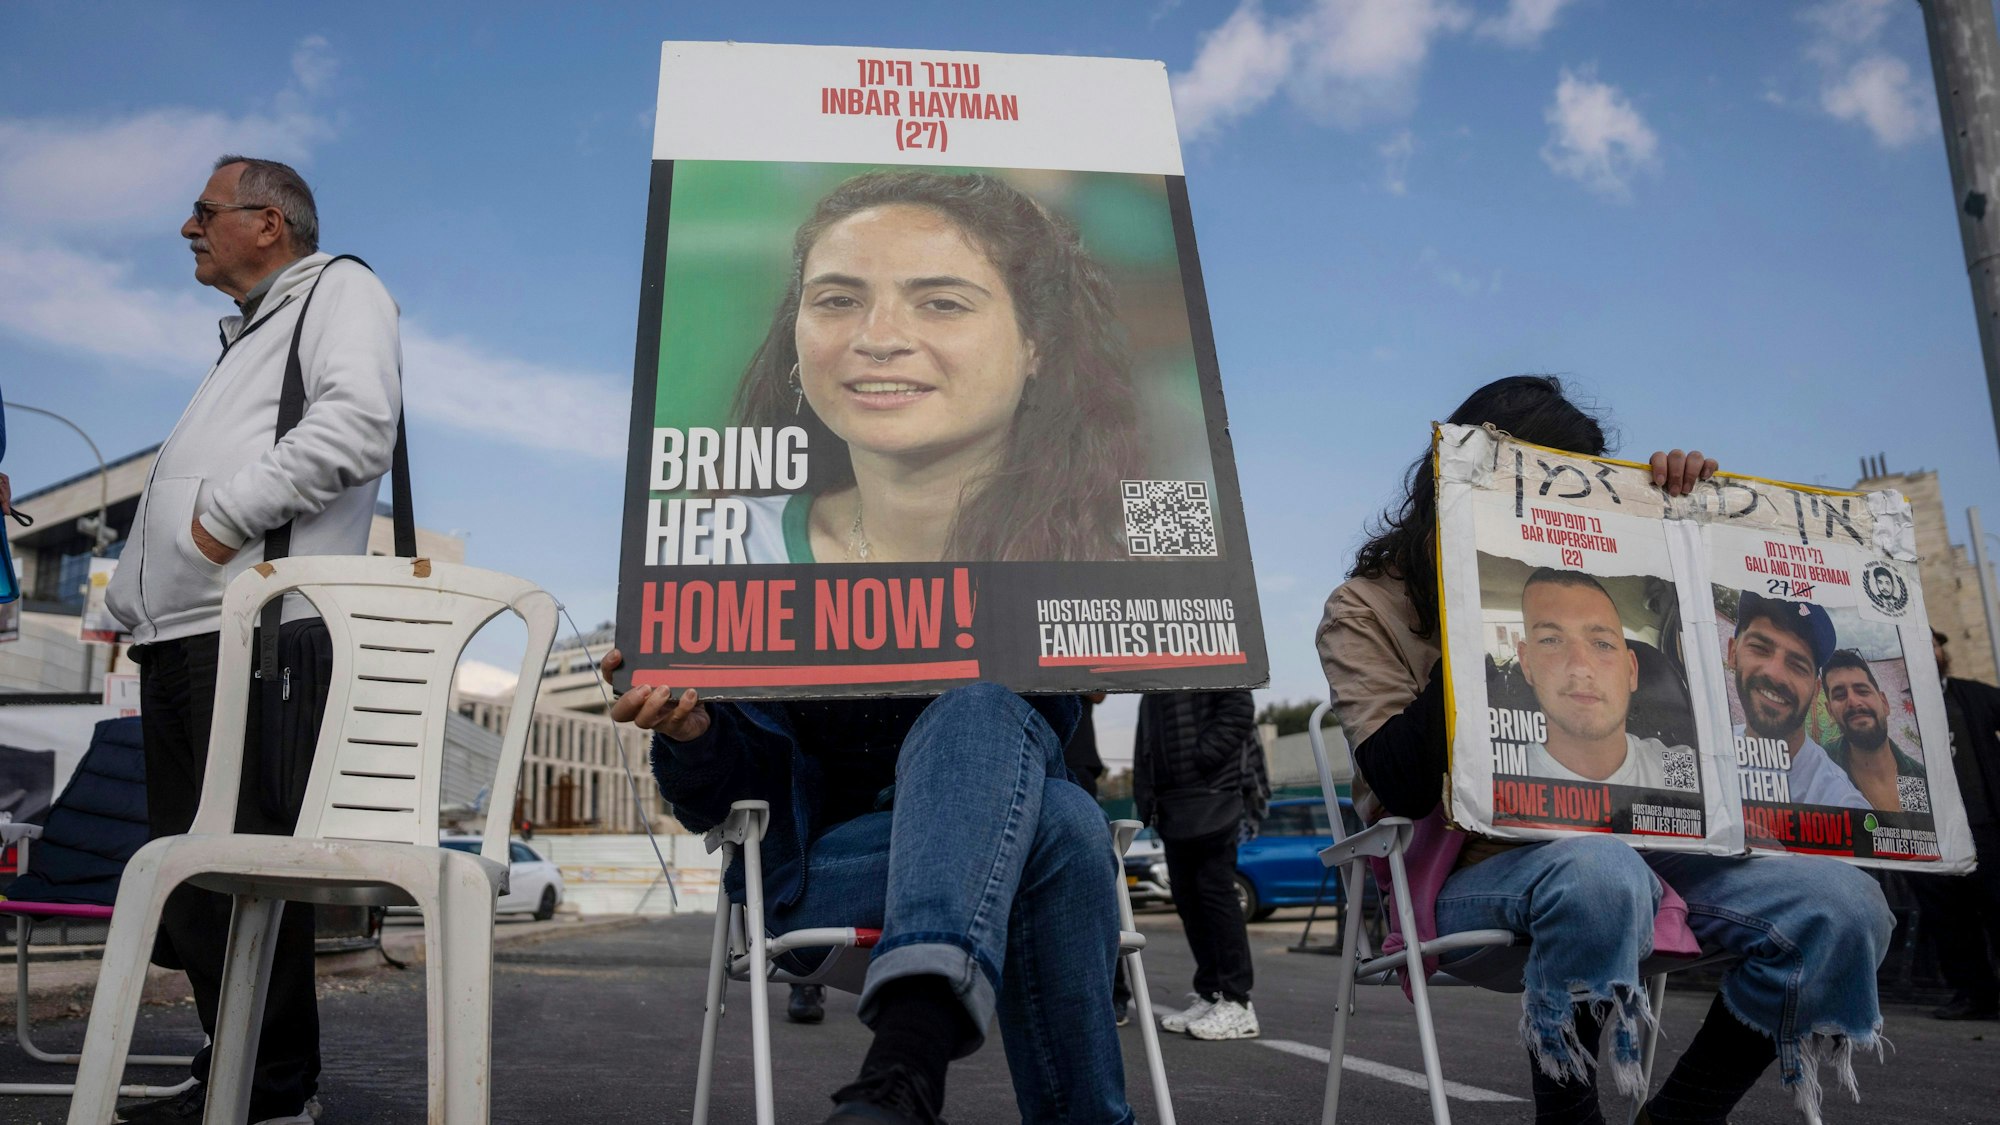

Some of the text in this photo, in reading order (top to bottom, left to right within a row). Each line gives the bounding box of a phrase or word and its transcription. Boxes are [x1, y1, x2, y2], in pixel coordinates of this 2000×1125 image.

[857, 59, 980, 89] ענבר הימן
[822, 88, 1019, 121] INBAR HAYMAN
[896, 119, 948, 152] (27)
[650, 426, 809, 492] BRING
[1509, 448, 1621, 518] זמן
[645, 498, 748, 565] HER
[1531, 508, 1601, 532] בר קופרשטיין
[1521, 524, 1617, 553] BAR KUPERSHTEIN
[1561, 547, 1583, 568] (22)
[1745, 555, 1768, 572] GALI
[1770, 559, 1789, 576] AND
[1791, 563, 1806, 578] ZIV
[1808, 565, 1850, 585] BERMAN
[1807, 547, 1823, 564] גלי
[1766, 579, 1789, 596] 27
[640, 579, 796, 655] HOME
[1037, 598, 1234, 622] HOSTAGES AND MISSING
[1039, 622, 1240, 658] FAMILIES FORUM
[1488, 708, 1547, 743] BRING
[1491, 742, 1527, 775] HIM
[1733, 736, 1790, 769] BRING
[1493, 781, 1547, 816] HOME
[1737, 770, 1790, 803] THEM
[1632, 803, 1700, 819] HOSTAGES AND MISSING
[1632, 815, 1700, 835] FAMILIES FORUM
[1742, 807, 1795, 841] HOME
[1872, 837, 1940, 855] FAMILIES FORUM
[1900, 828, 1911, 838] AND
[1912, 829, 1935, 841] MISSING
